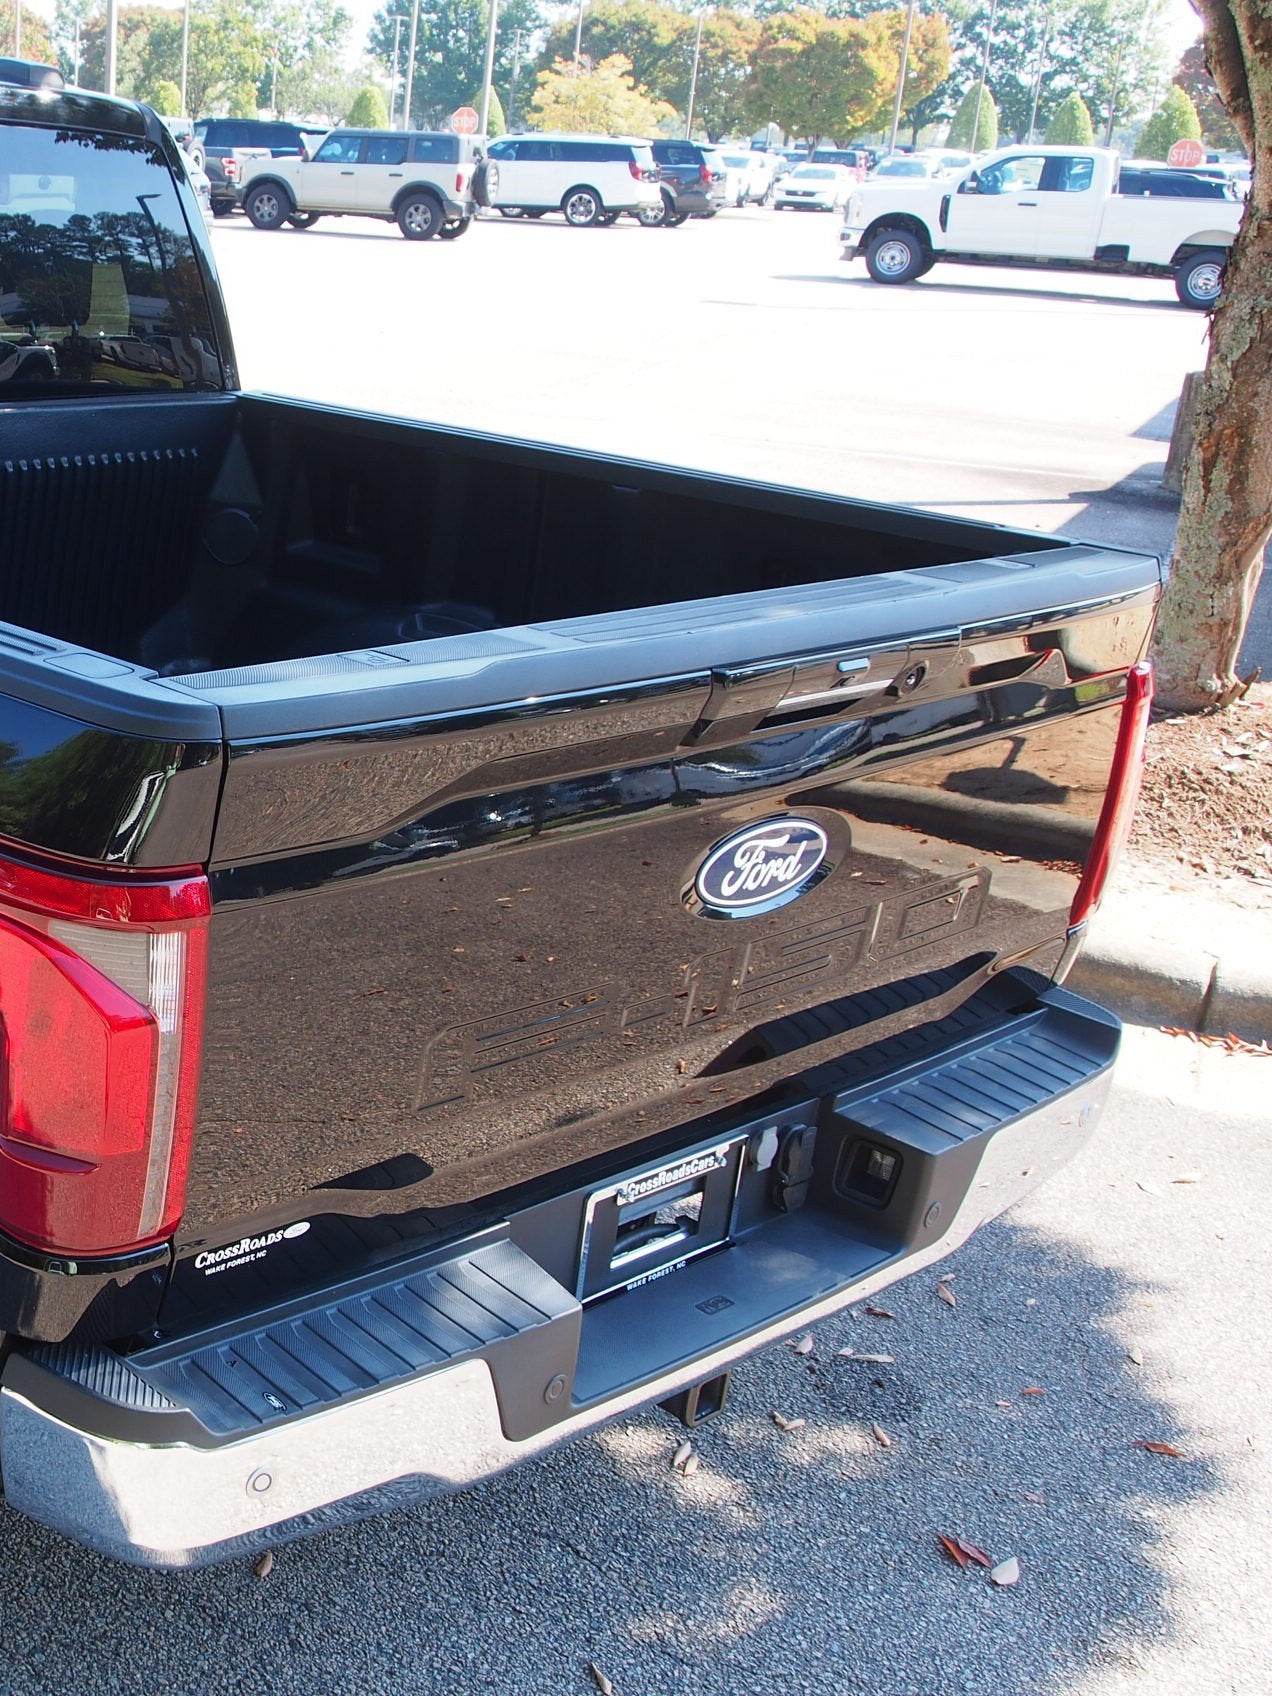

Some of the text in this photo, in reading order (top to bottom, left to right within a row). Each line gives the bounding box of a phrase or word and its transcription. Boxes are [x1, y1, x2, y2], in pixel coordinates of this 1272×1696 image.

[453, 116, 476, 128] STOP
[1170, 149, 1201, 163] STOP
[720, 834, 808, 897] Ford
[414, 866, 993, 1111] F-150
[205, 1250, 267, 1275] WAKE FOREST, NC
[627, 1277, 647, 1291] WAKE
[676, 1260, 687, 1270] NC
